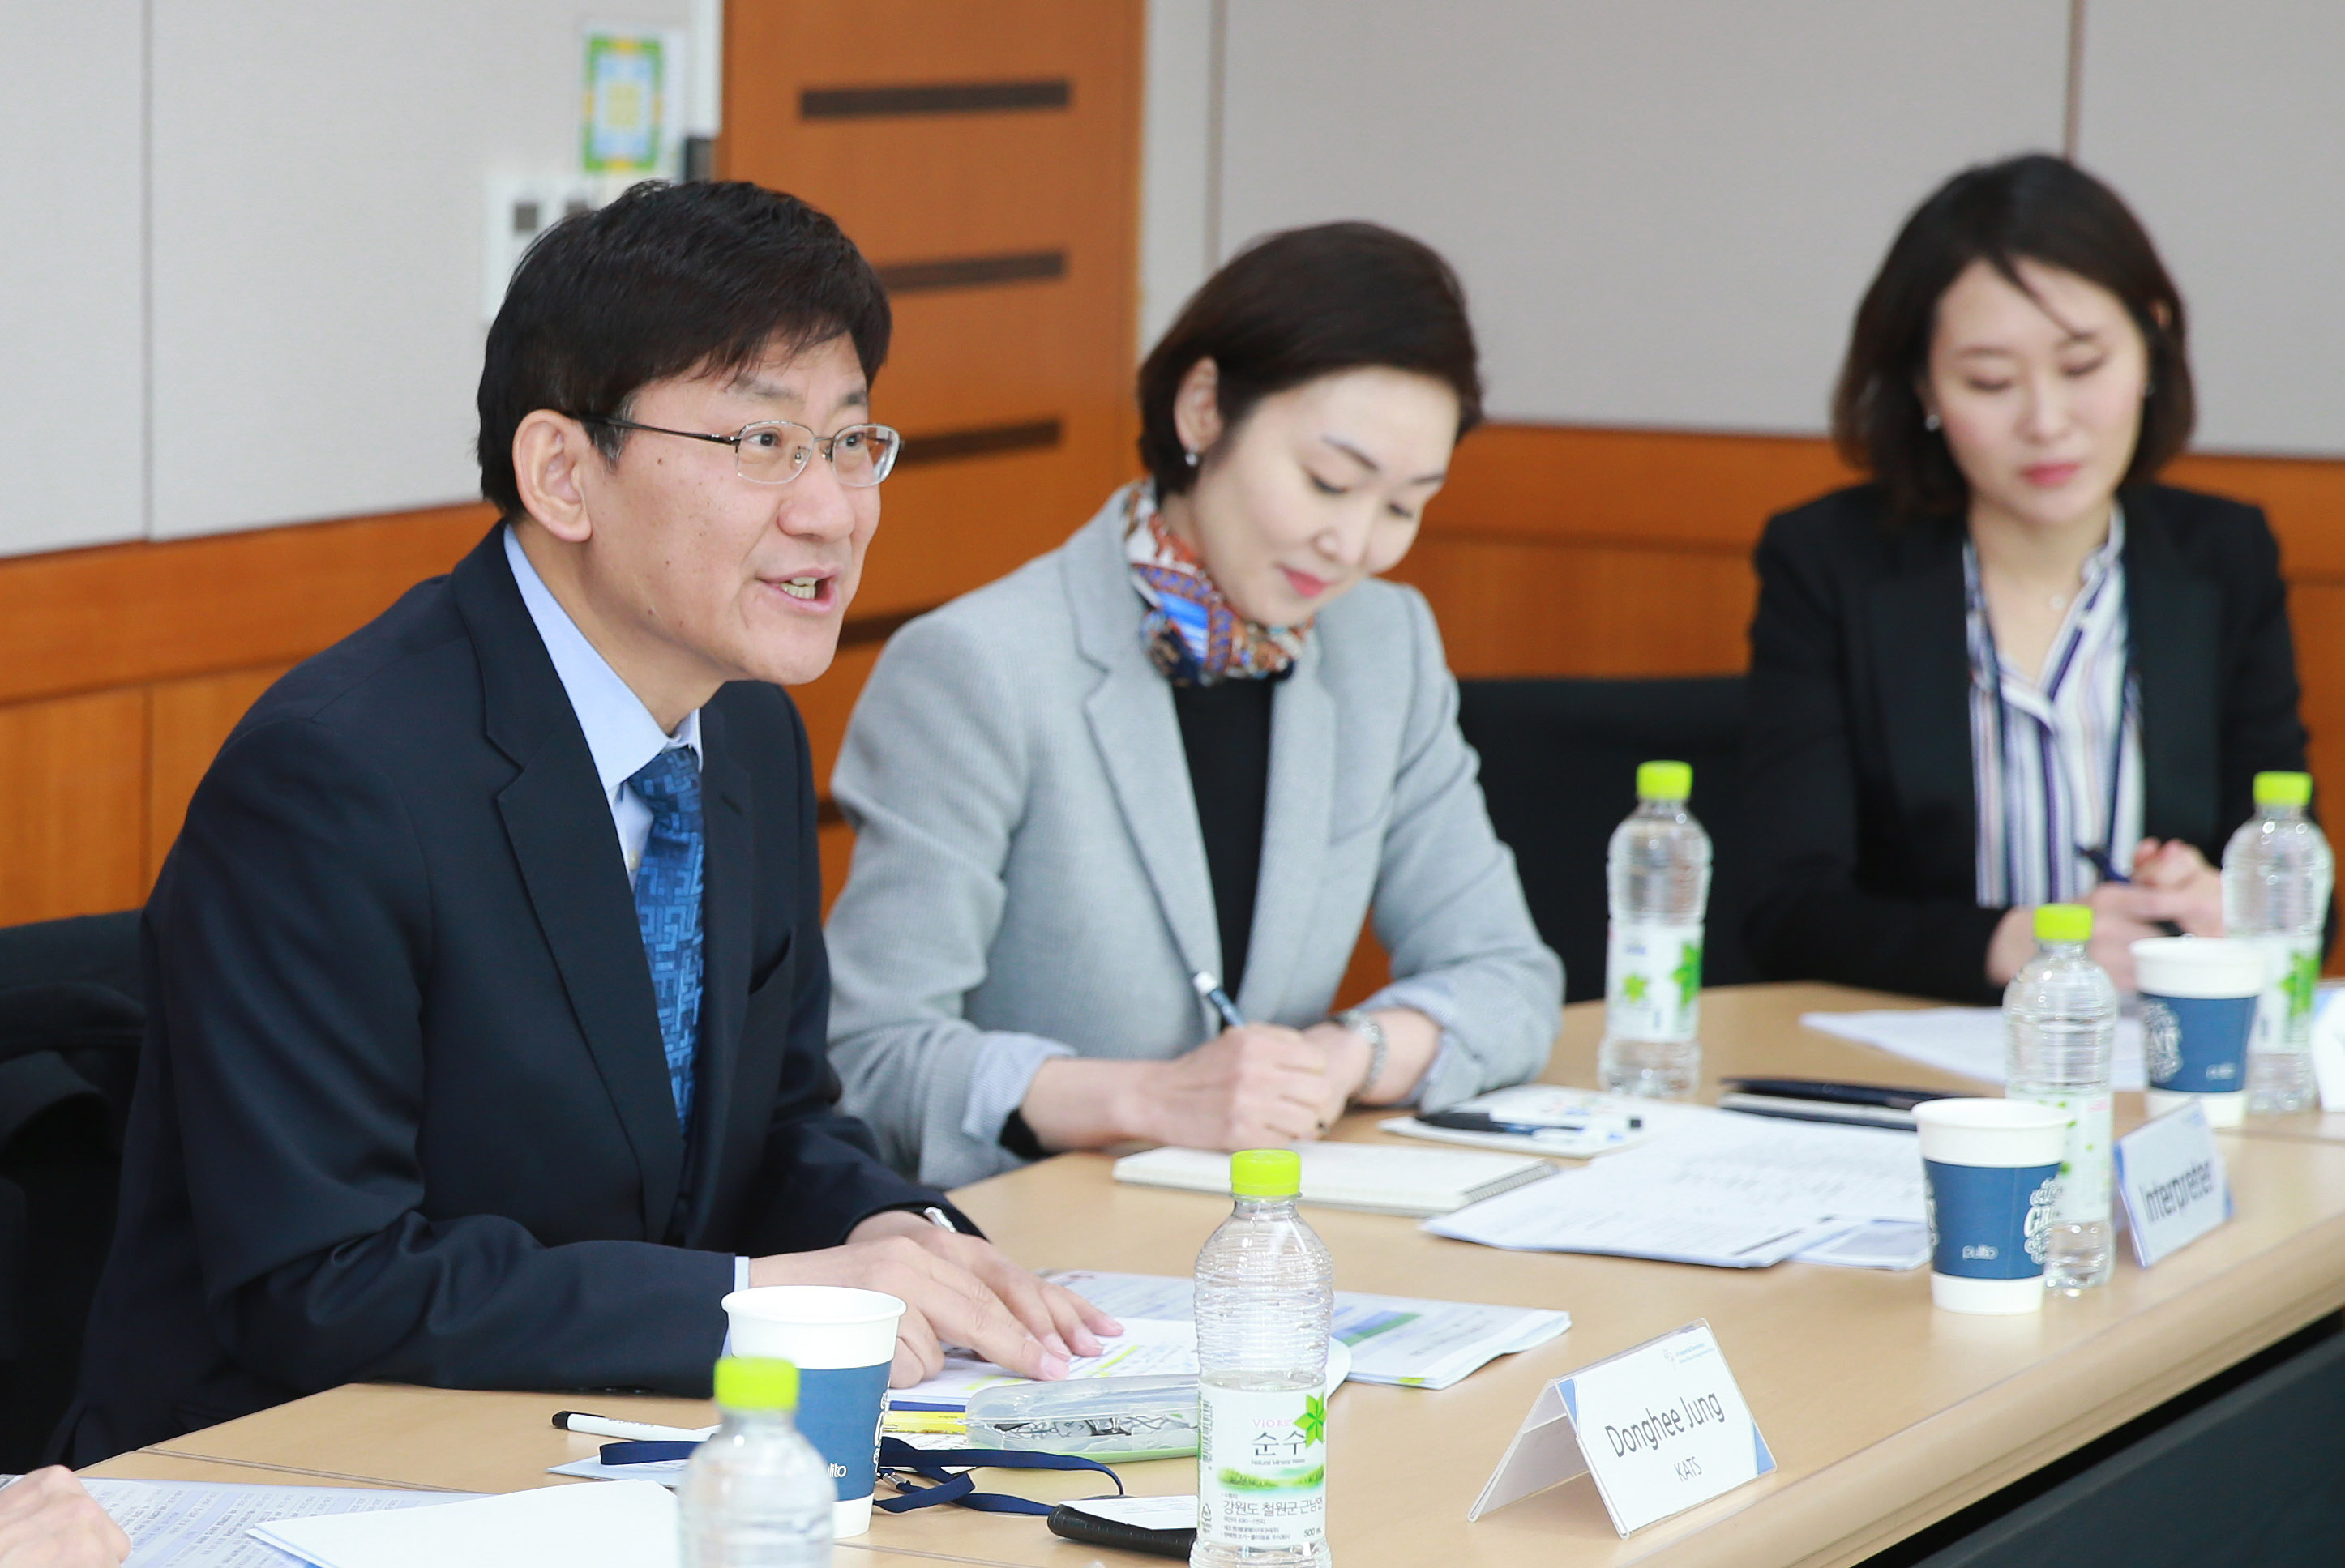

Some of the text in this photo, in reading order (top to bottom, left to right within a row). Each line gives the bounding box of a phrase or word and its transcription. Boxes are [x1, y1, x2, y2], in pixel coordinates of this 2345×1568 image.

[2138, 1160, 2214, 1224] Interpreter
[1605, 1393, 1725, 1458] Donghee Jung
[826, 1463, 847, 1478] lito
[1674, 1456, 1702, 1482] KATS
[1223, 1500, 1259, 1515] 강원도
[1261, 1502, 1298, 1517] 철원군
[1303, 1527, 1315, 1538] 500
